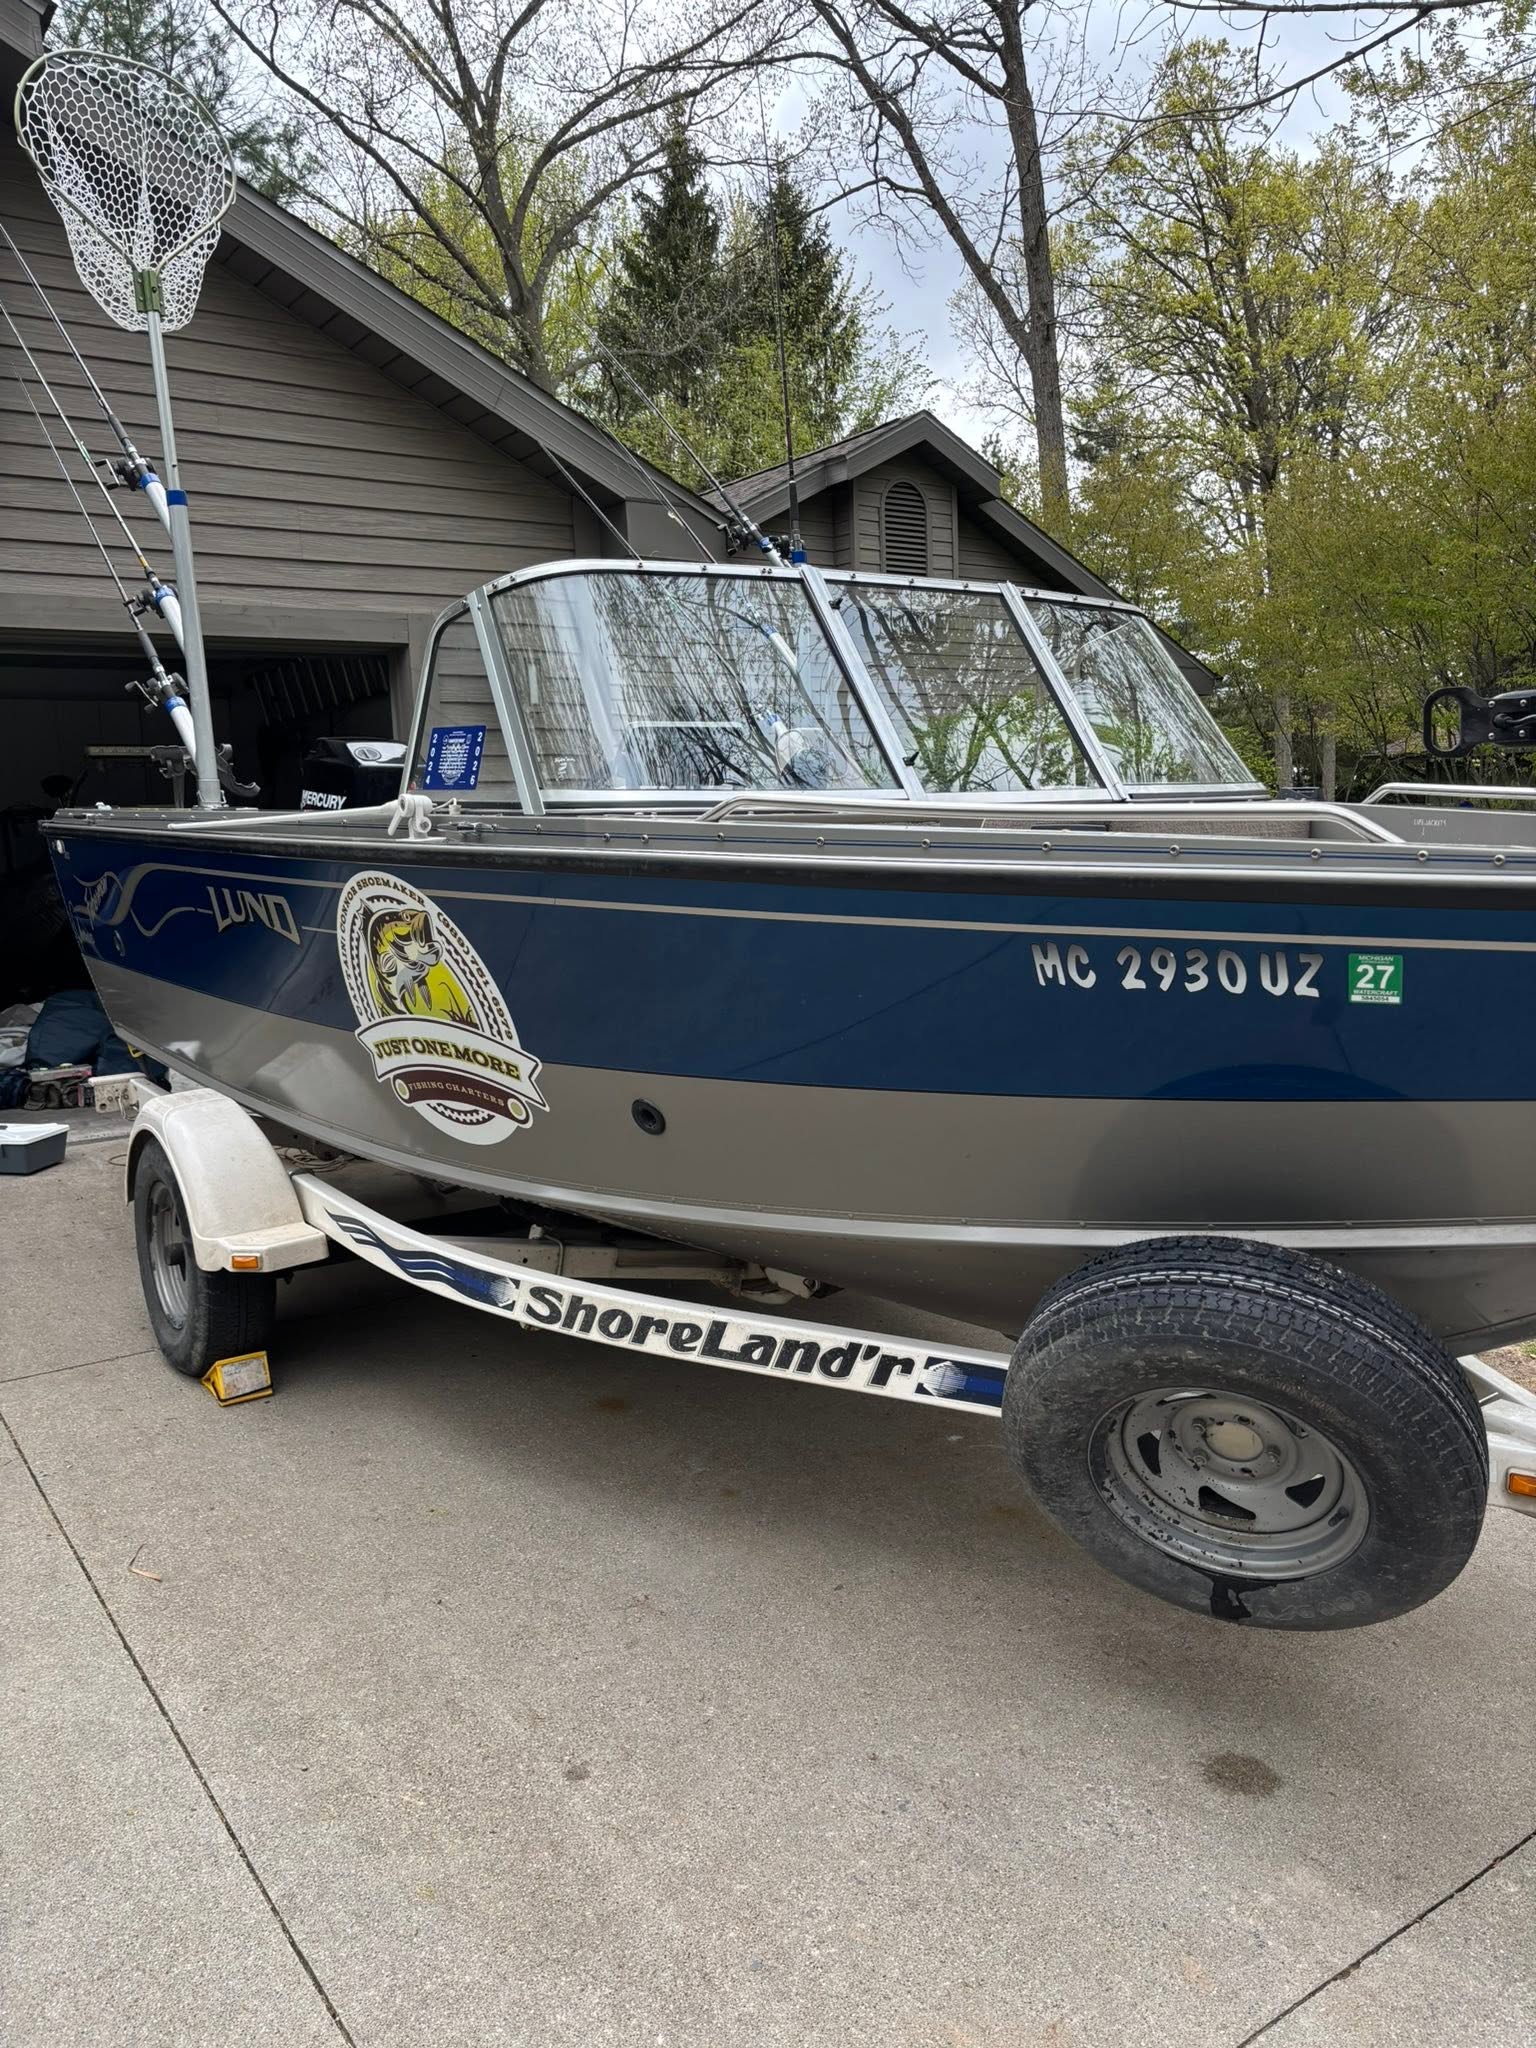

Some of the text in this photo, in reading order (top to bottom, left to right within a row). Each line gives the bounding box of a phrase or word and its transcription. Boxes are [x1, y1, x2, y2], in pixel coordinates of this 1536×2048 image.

[302, 789, 348, 810] MERCURY
[356, 876, 425, 908] SHOEMAKER
[206, 886, 300, 945] LUND
[1031, 942, 1324, 998] MC 2930 UZ
[1356, 964, 1395, 989] 27
[374, 1037, 522, 1082] JUST ONE MORE
[408, 1080, 505, 1107] FISHING CHARTERS
[525, 1285, 916, 1389] ShoreLand'r
